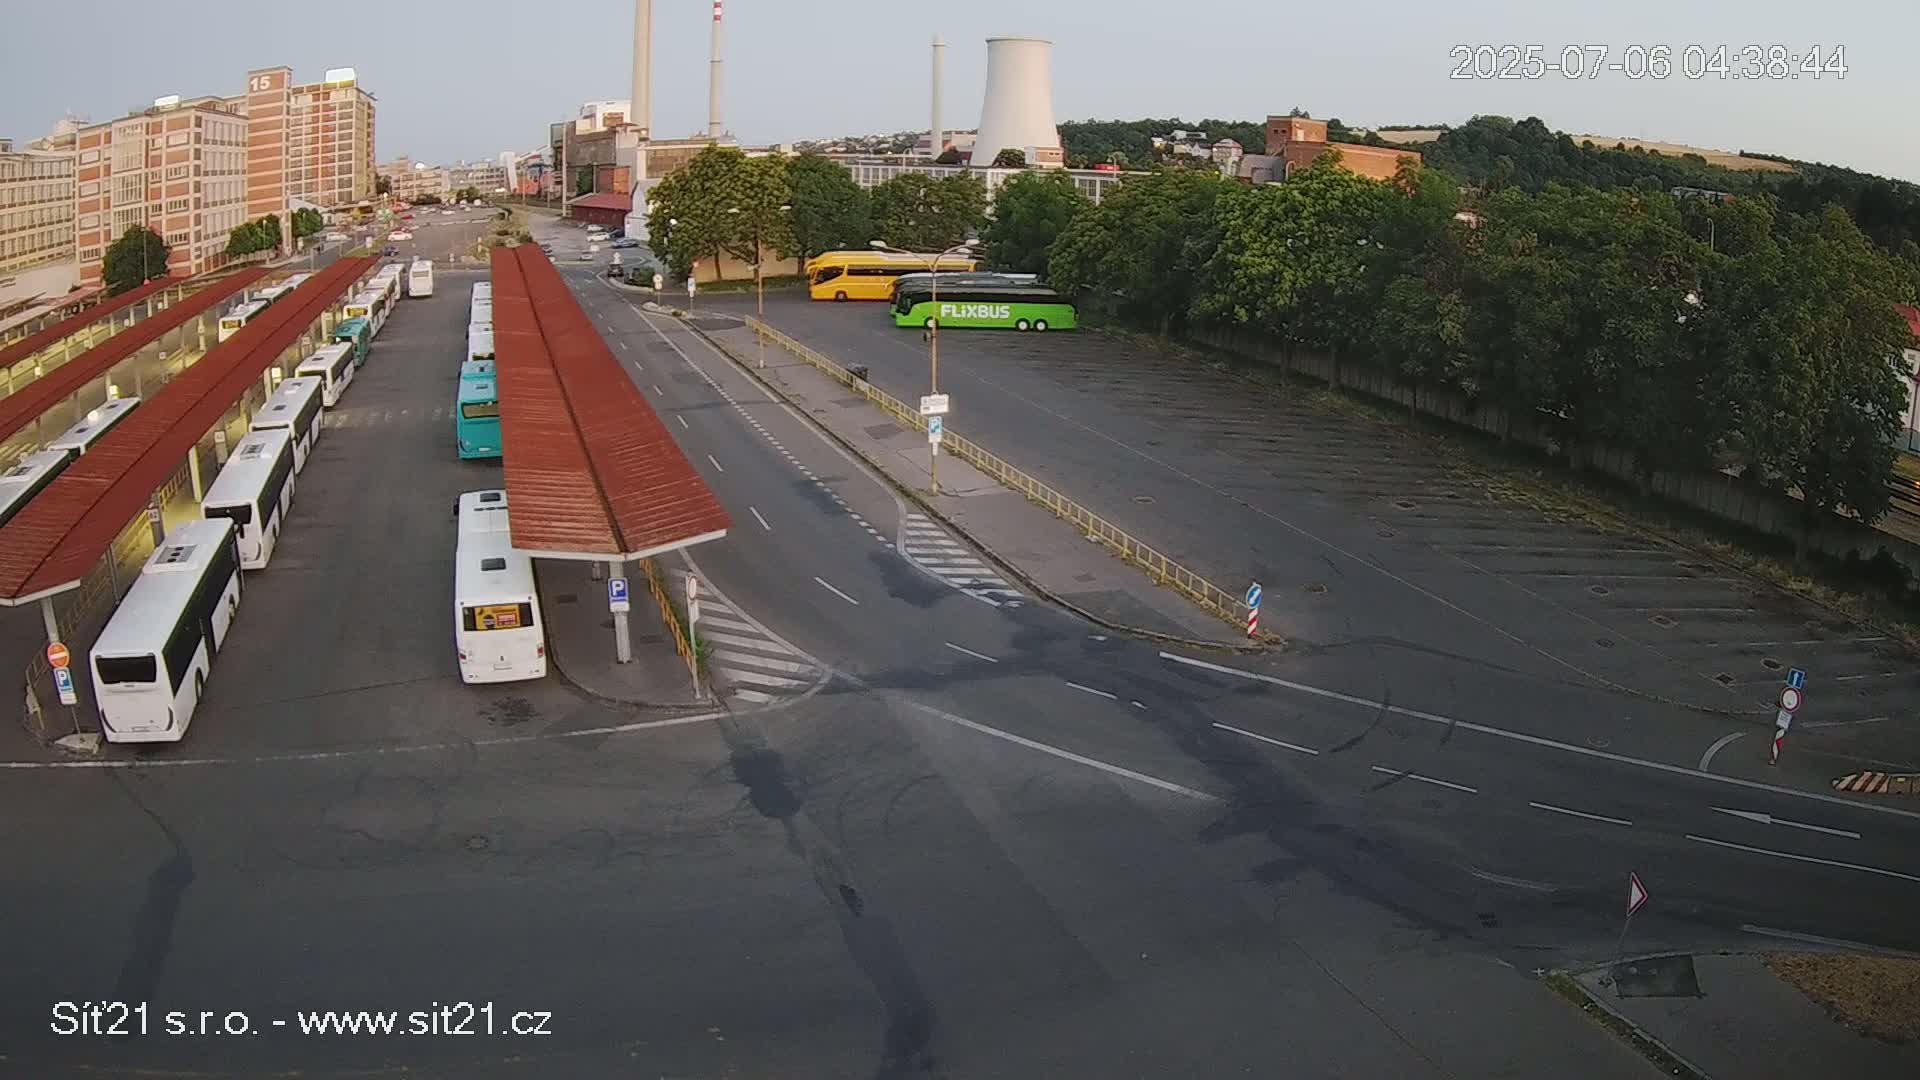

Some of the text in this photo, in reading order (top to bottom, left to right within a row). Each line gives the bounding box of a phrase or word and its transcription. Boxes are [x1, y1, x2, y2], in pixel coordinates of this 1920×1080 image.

[250, 75, 271, 92] 15
[612, 581, 625, 596] P
[58, 671, 69, 687] P
